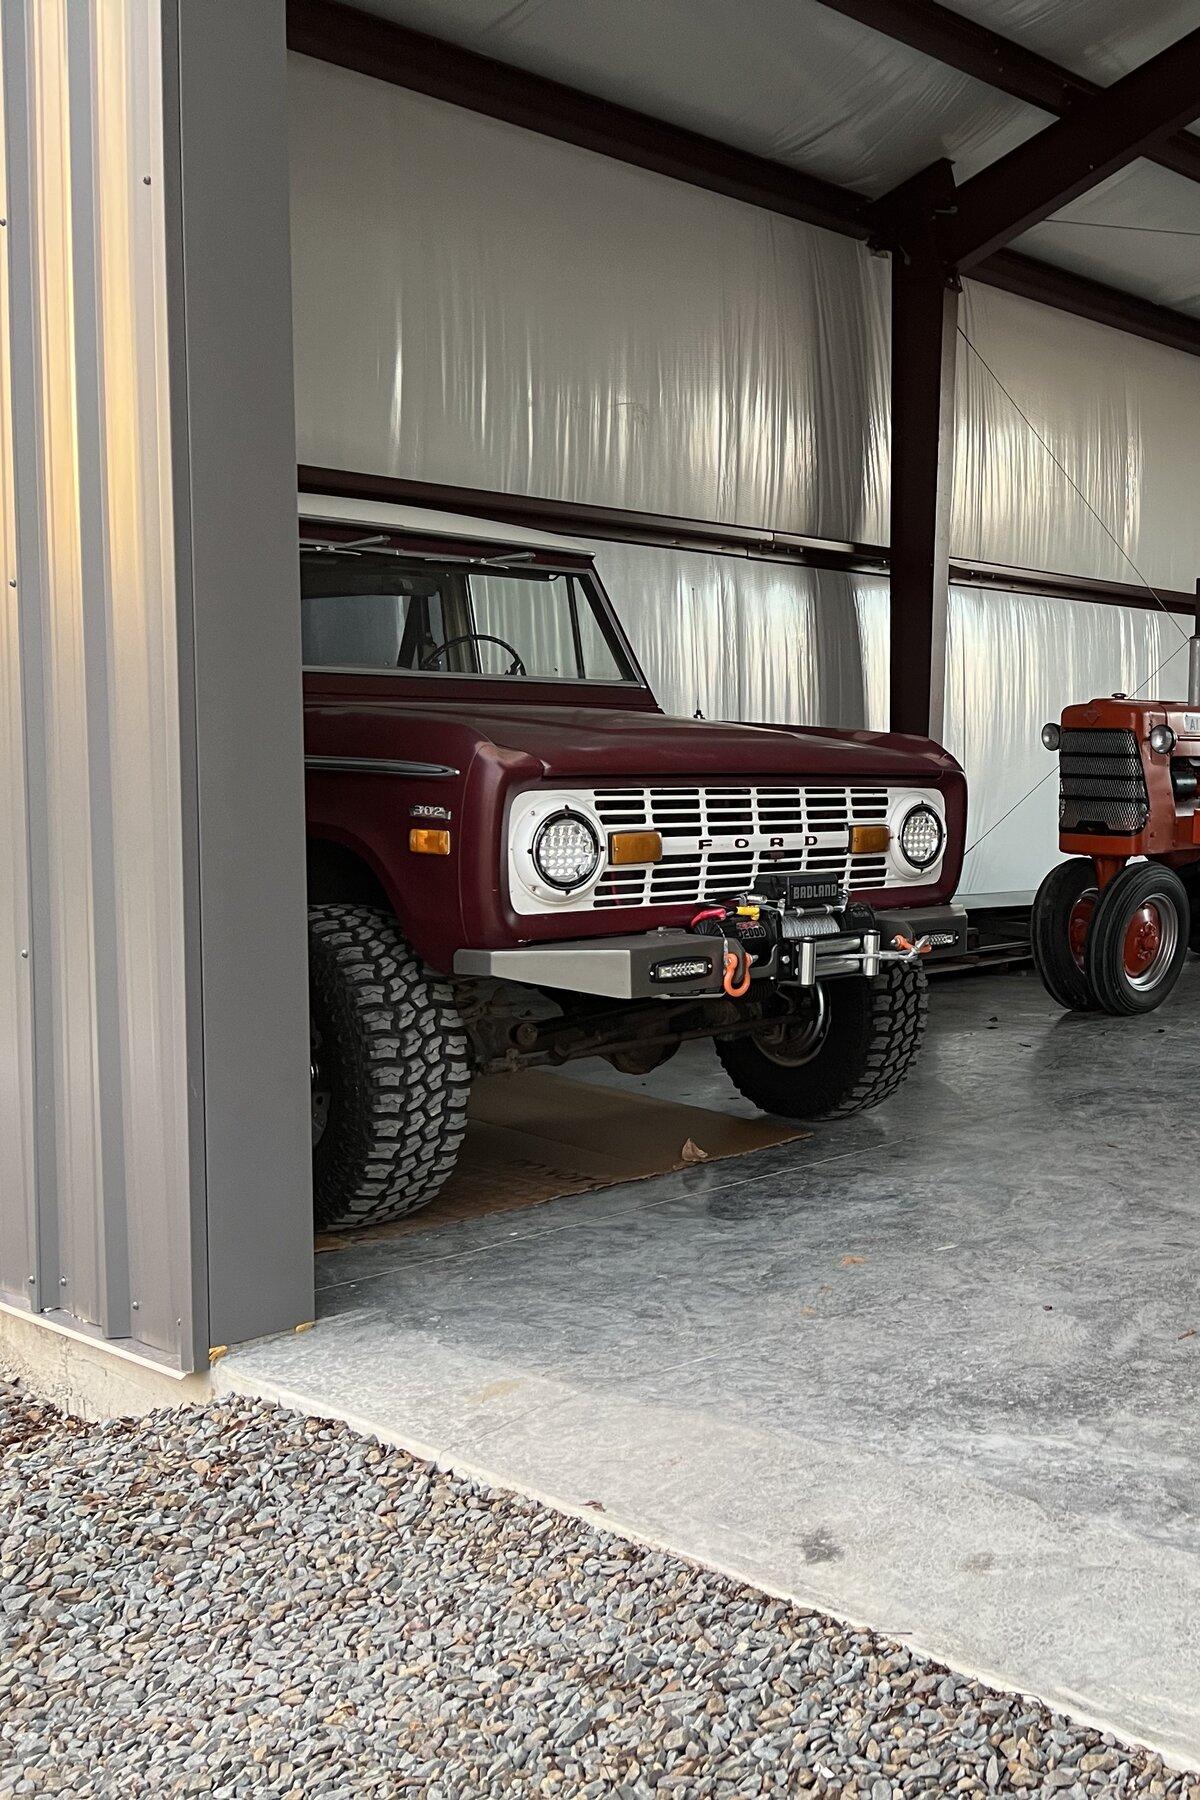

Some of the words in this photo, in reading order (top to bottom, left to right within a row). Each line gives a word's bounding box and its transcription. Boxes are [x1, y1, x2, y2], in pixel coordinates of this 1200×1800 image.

[413, 804, 446, 817] 302
[698, 835, 818, 850] FORD
[793, 883, 838, 900] BADLAND
